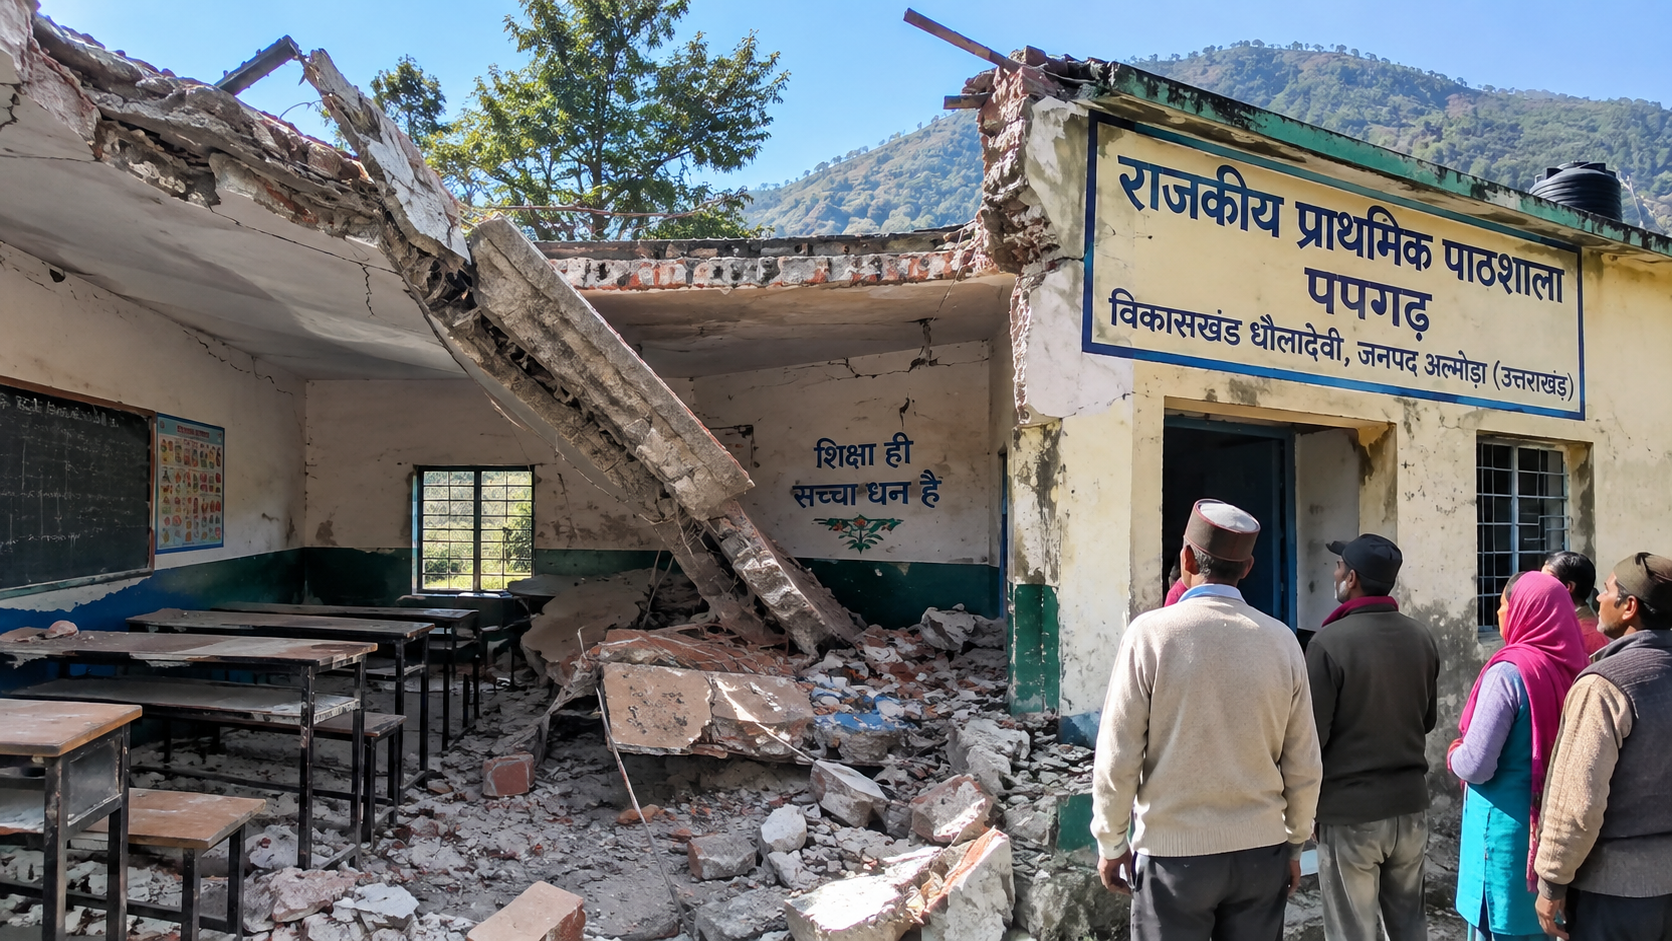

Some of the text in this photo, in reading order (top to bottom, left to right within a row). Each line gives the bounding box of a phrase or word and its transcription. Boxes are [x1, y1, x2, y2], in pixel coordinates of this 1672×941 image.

[1117, 155, 1565, 303] राजकीय प्राथमिक पाठशाला
[1108, 287, 1242, 346] विकासखंड
[1250, 313, 1351, 367] धौलादेवी,
[1357, 340, 1418, 377] जनपद
[1426, 349, 1487, 389] अल्मोड़ा
[1304, 267, 1432, 341] पपगढ़
[814, 432, 914, 470] शिक्षा ही
[792, 469, 943, 509] सच्चा धन है
